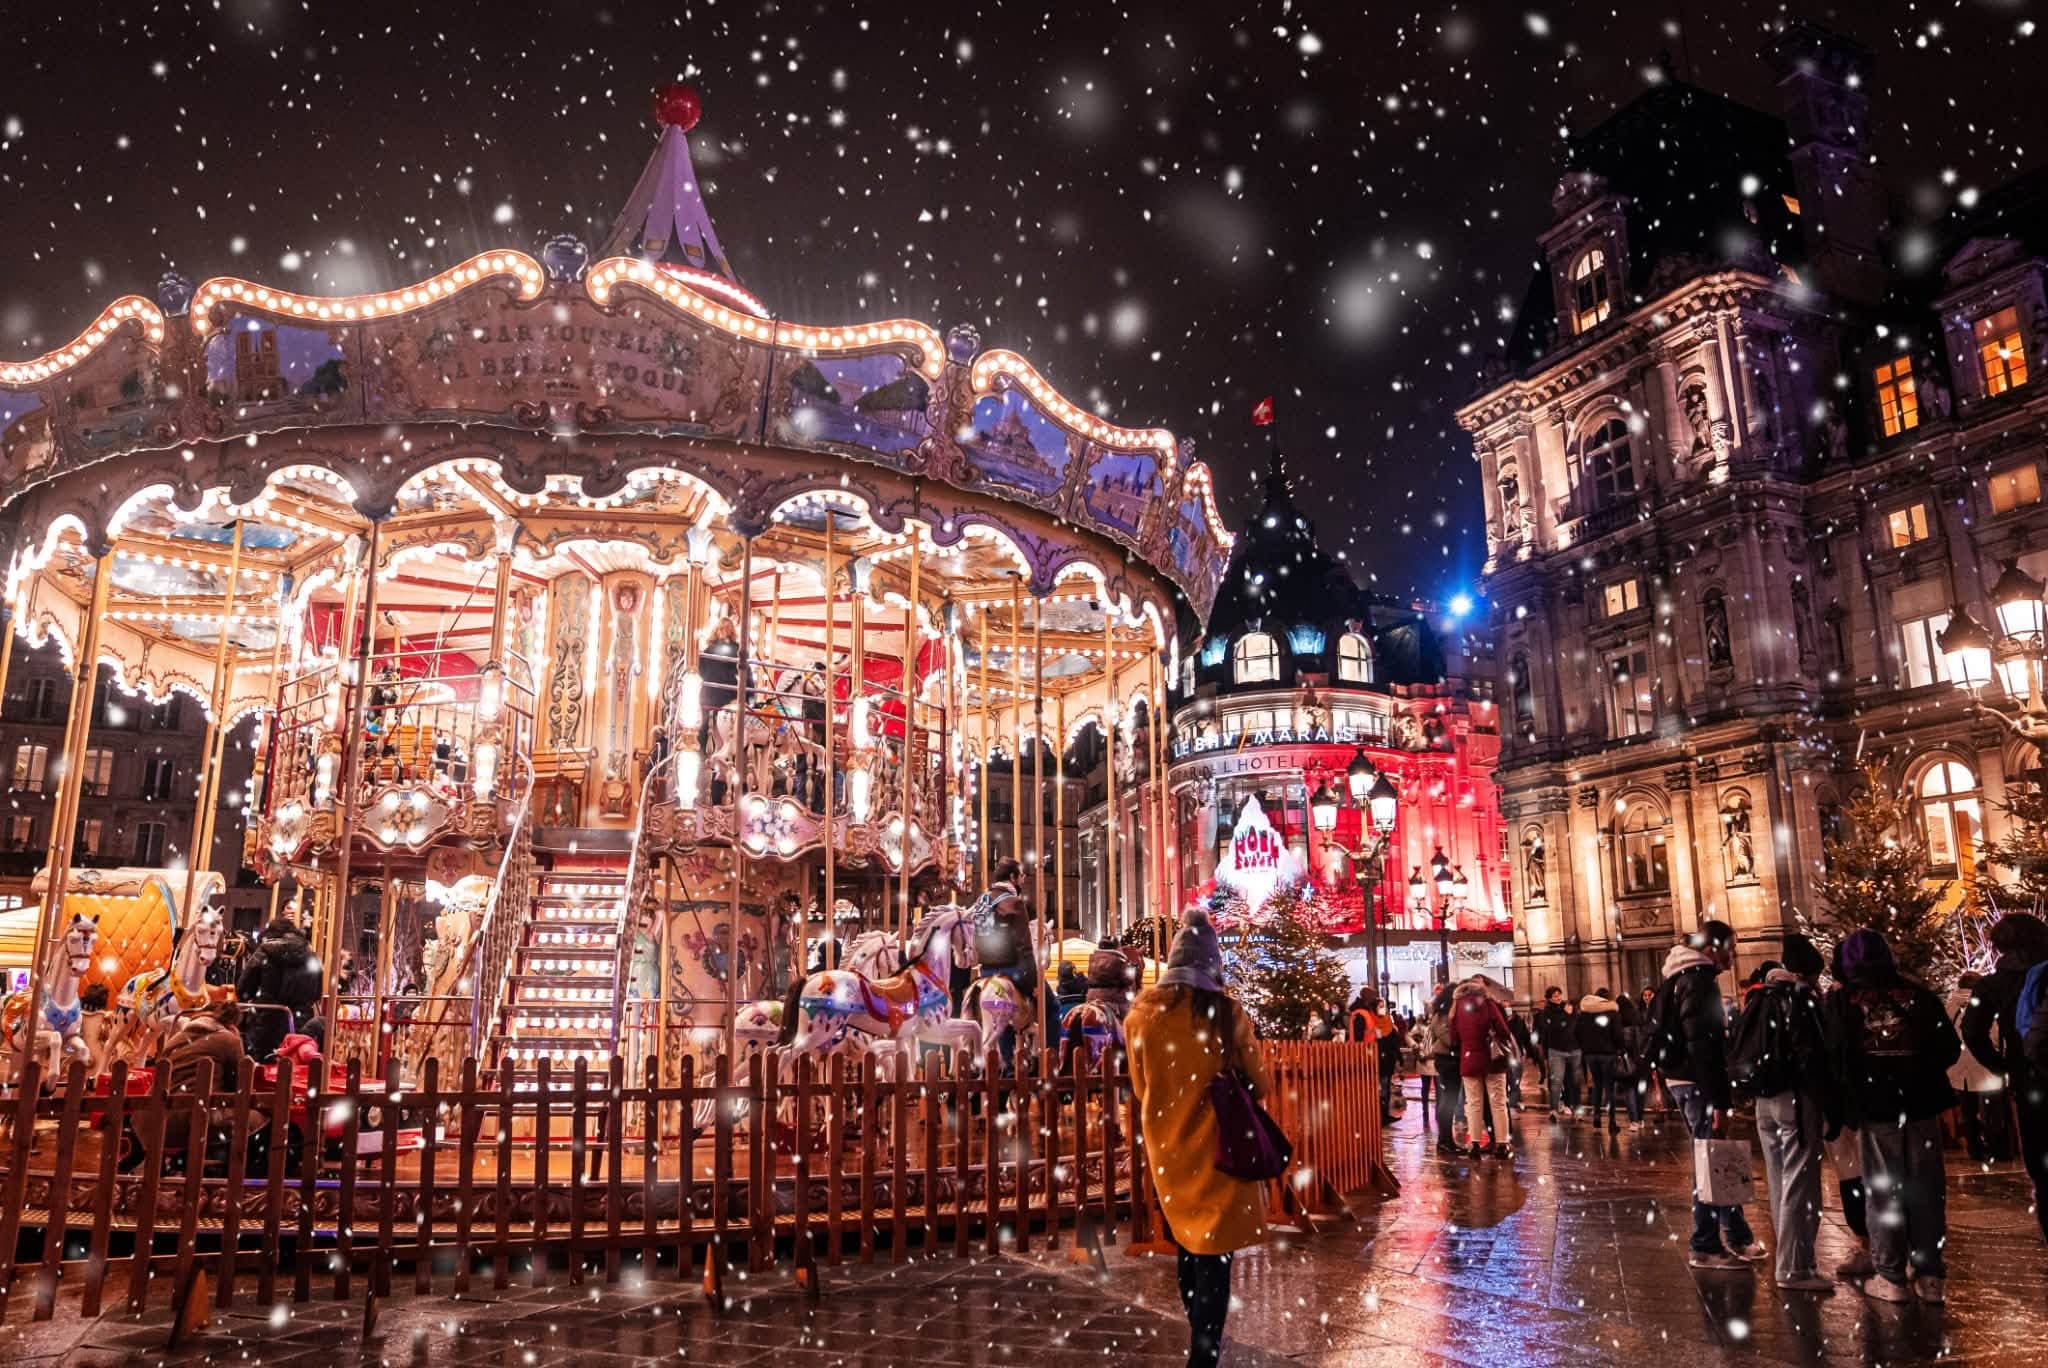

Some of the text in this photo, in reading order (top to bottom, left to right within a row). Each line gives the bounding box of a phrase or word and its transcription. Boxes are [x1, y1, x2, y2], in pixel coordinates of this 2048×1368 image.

[474, 325, 651, 354] CAROUSEL
[585, 360, 692, 396] POQUE
[1174, 741, 1190, 758] LE
[1194, 731, 1235, 752] BHV
[1254, 726, 1354, 745] MARAIS
